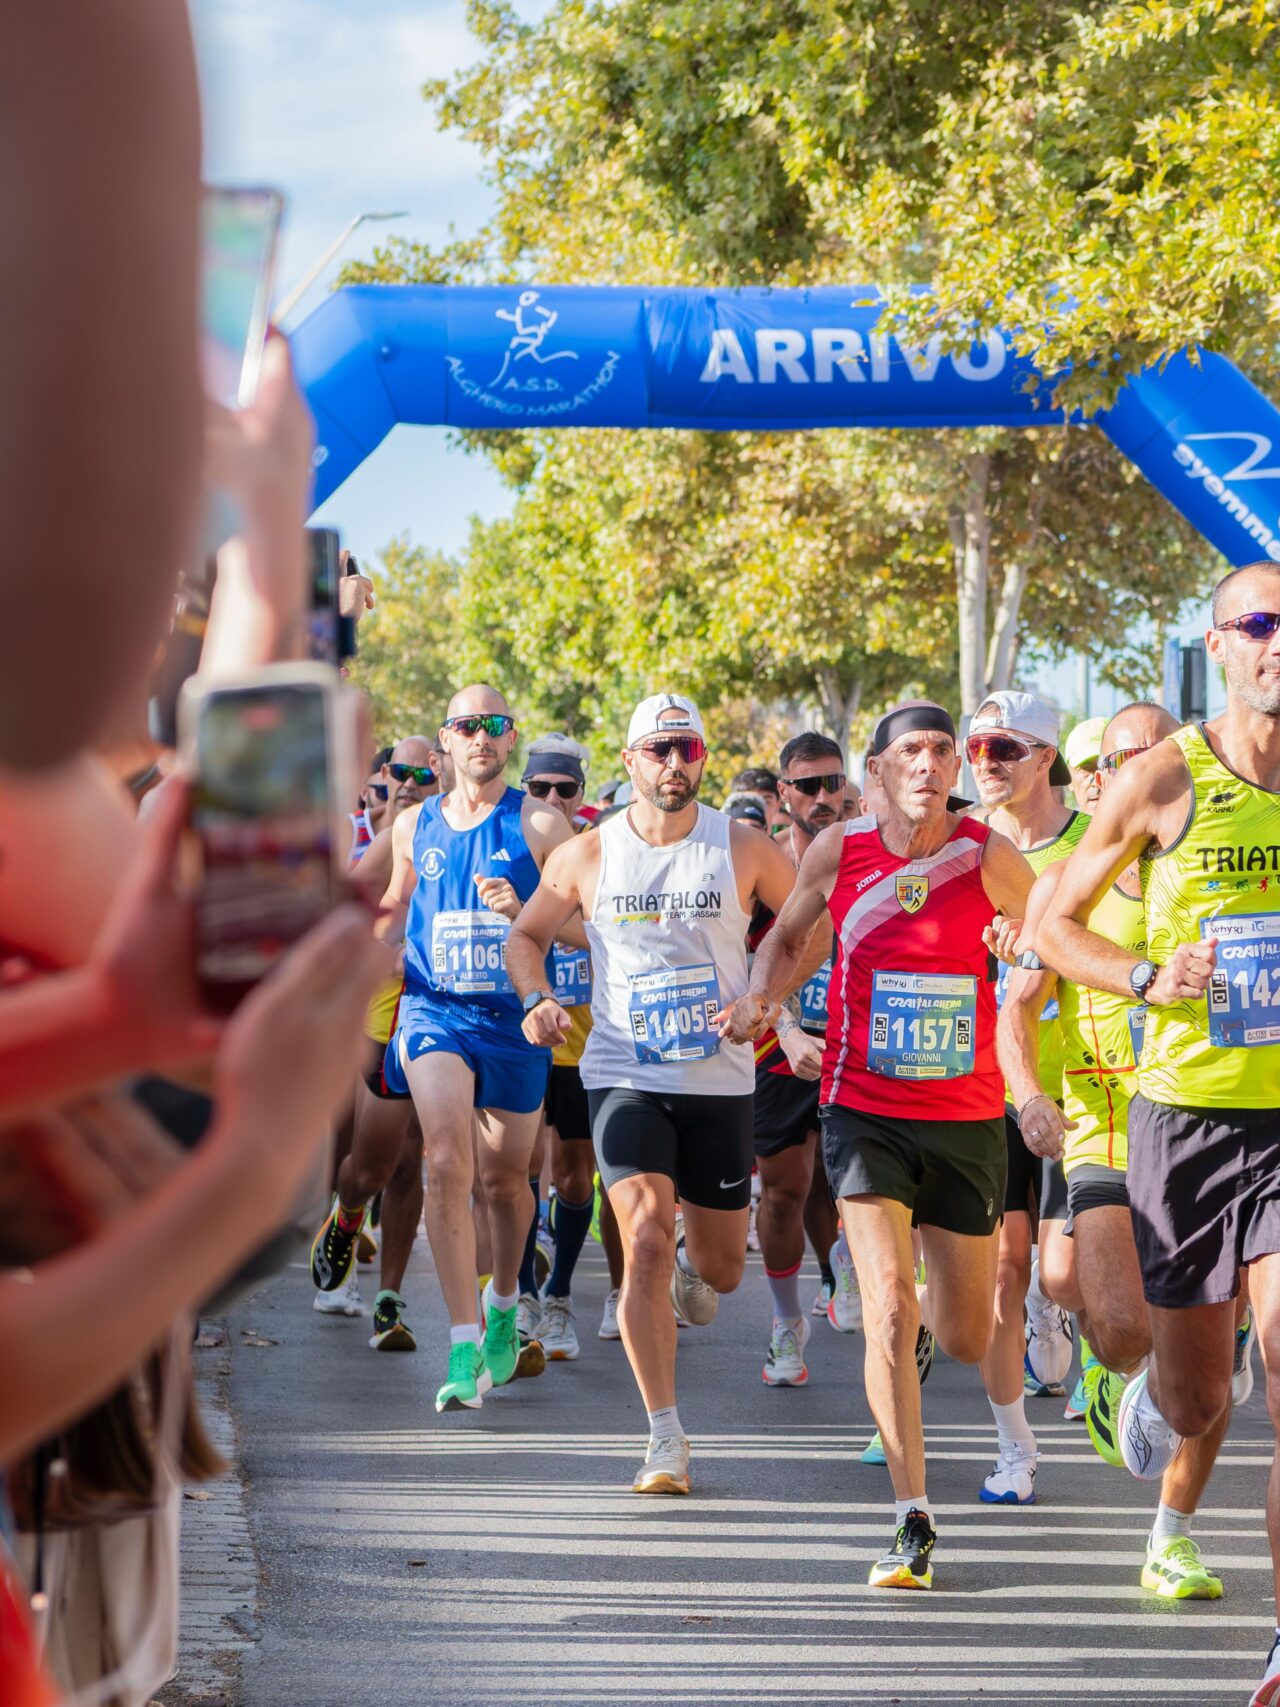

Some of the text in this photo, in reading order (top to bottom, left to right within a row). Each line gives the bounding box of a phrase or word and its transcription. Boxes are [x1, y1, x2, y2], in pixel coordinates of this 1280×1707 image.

[699, 328, 1006, 383] ARRIVO
[444, 350, 621, 417] ALGHERO MARATHON
[613, 891, 721, 914] TRIATHLON
[665, 911, 721, 920] TEAM SASSARI
[448, 944, 500, 970] 1106
[1222, 944, 1260, 960] CRAI
[460, 971, 488, 980] ALBERTO
[641, 991, 667, 1005] CRAI
[887, 996, 962, 1009] CRAI ALGHERO
[648, 1004, 705, 1038] 1405
[891, 1017, 954, 1050] 1157
[902, 1052, 941, 1063] GIOVANNI
